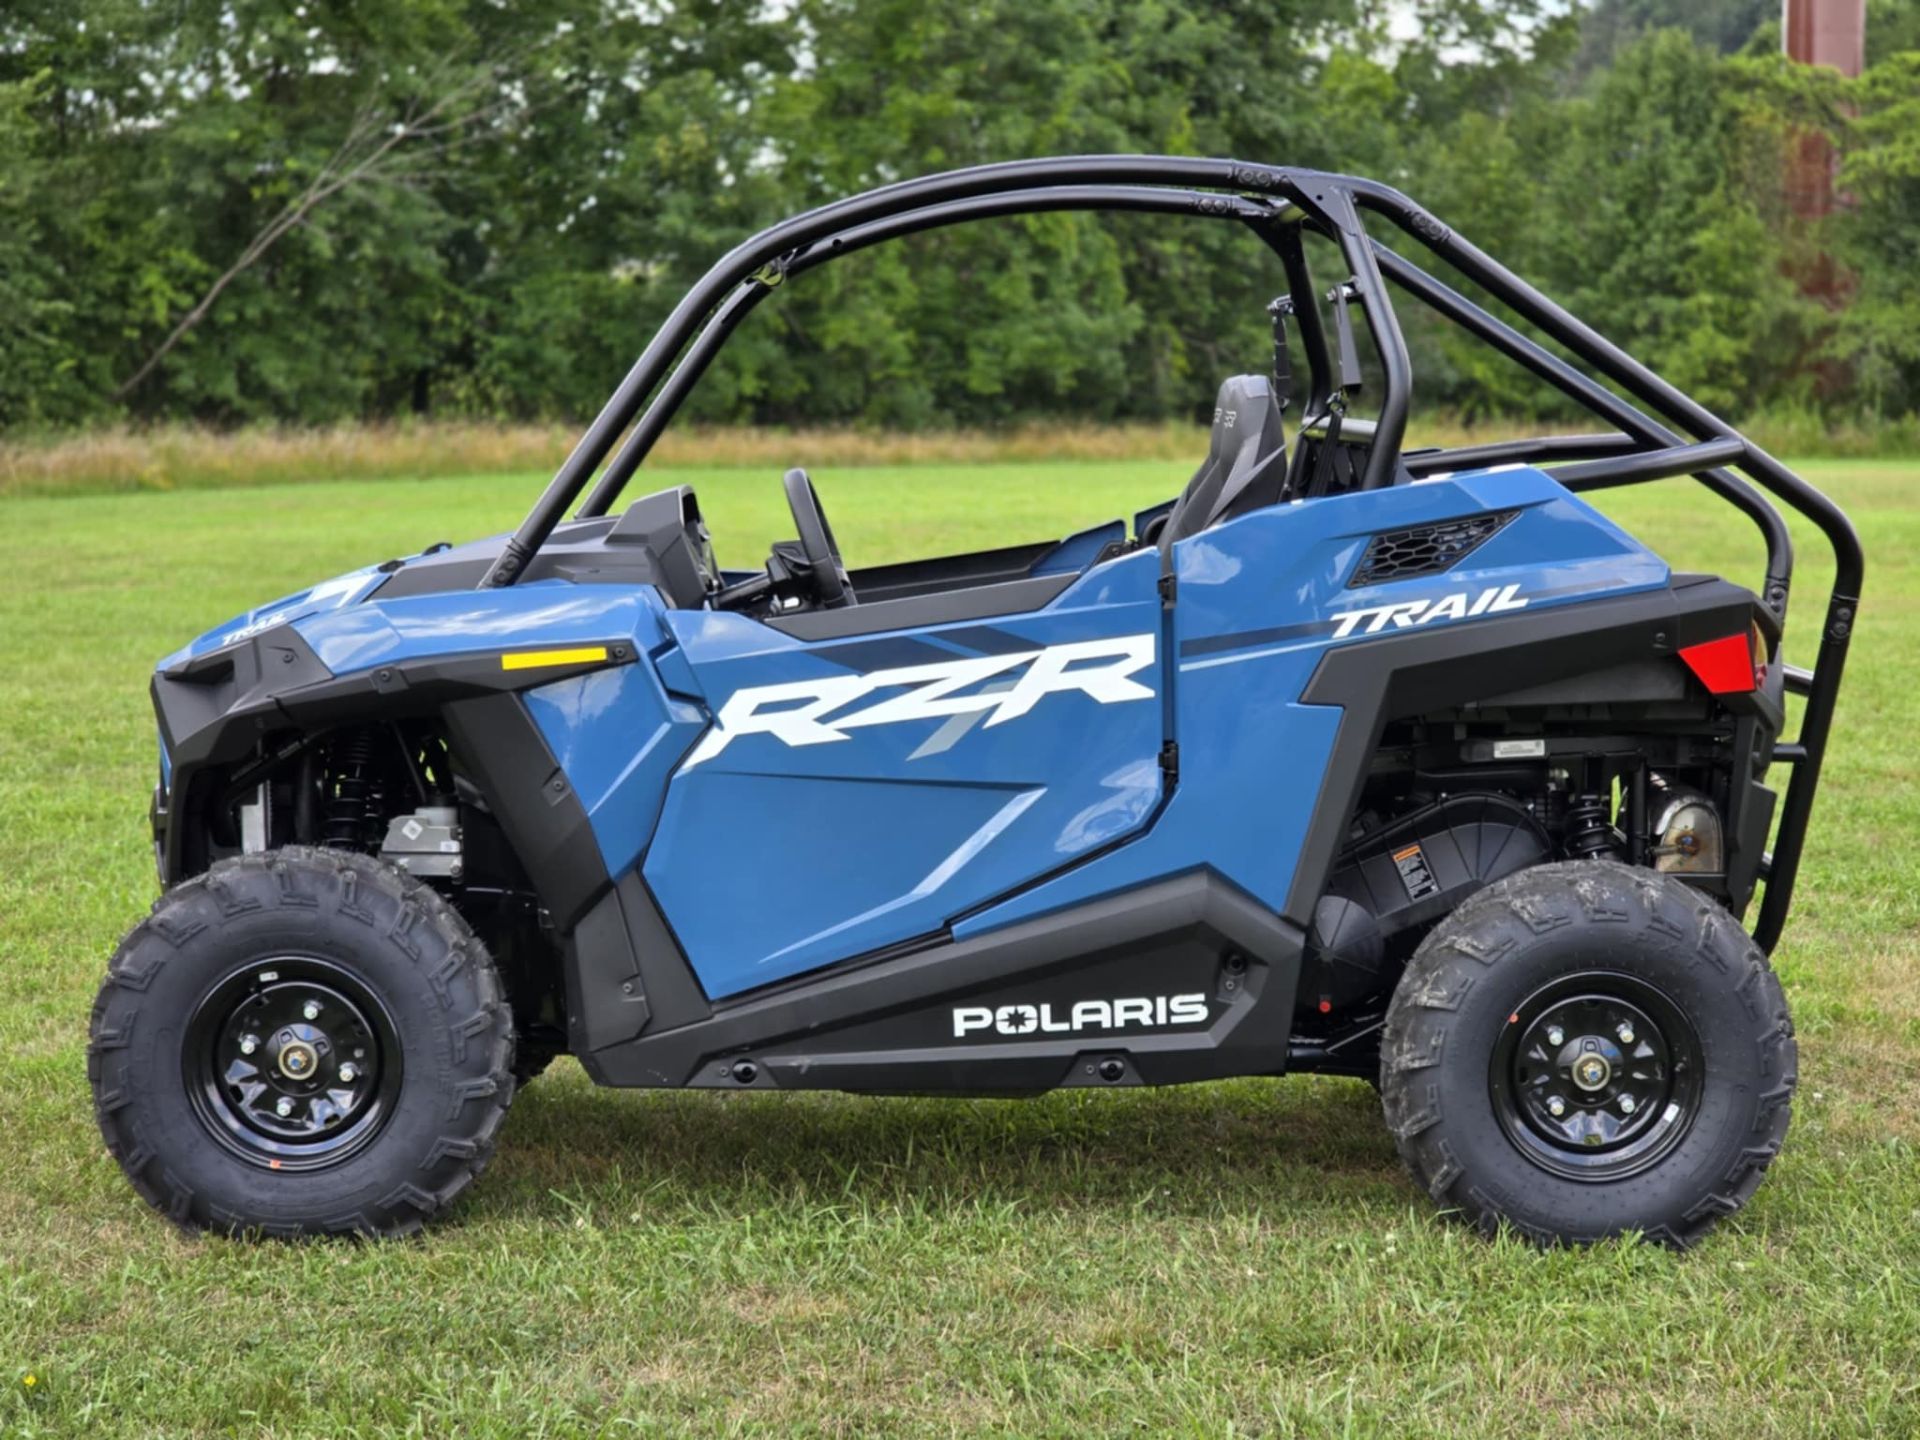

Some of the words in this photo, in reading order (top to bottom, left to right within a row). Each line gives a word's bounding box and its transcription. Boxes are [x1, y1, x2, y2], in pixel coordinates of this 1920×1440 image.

[222, 612, 287, 646] TRAIL
[1331, 584, 1529, 639] TRAIL
[677, 633, 1155, 775] RZR
[953, 993, 1209, 1037] POLARIS
